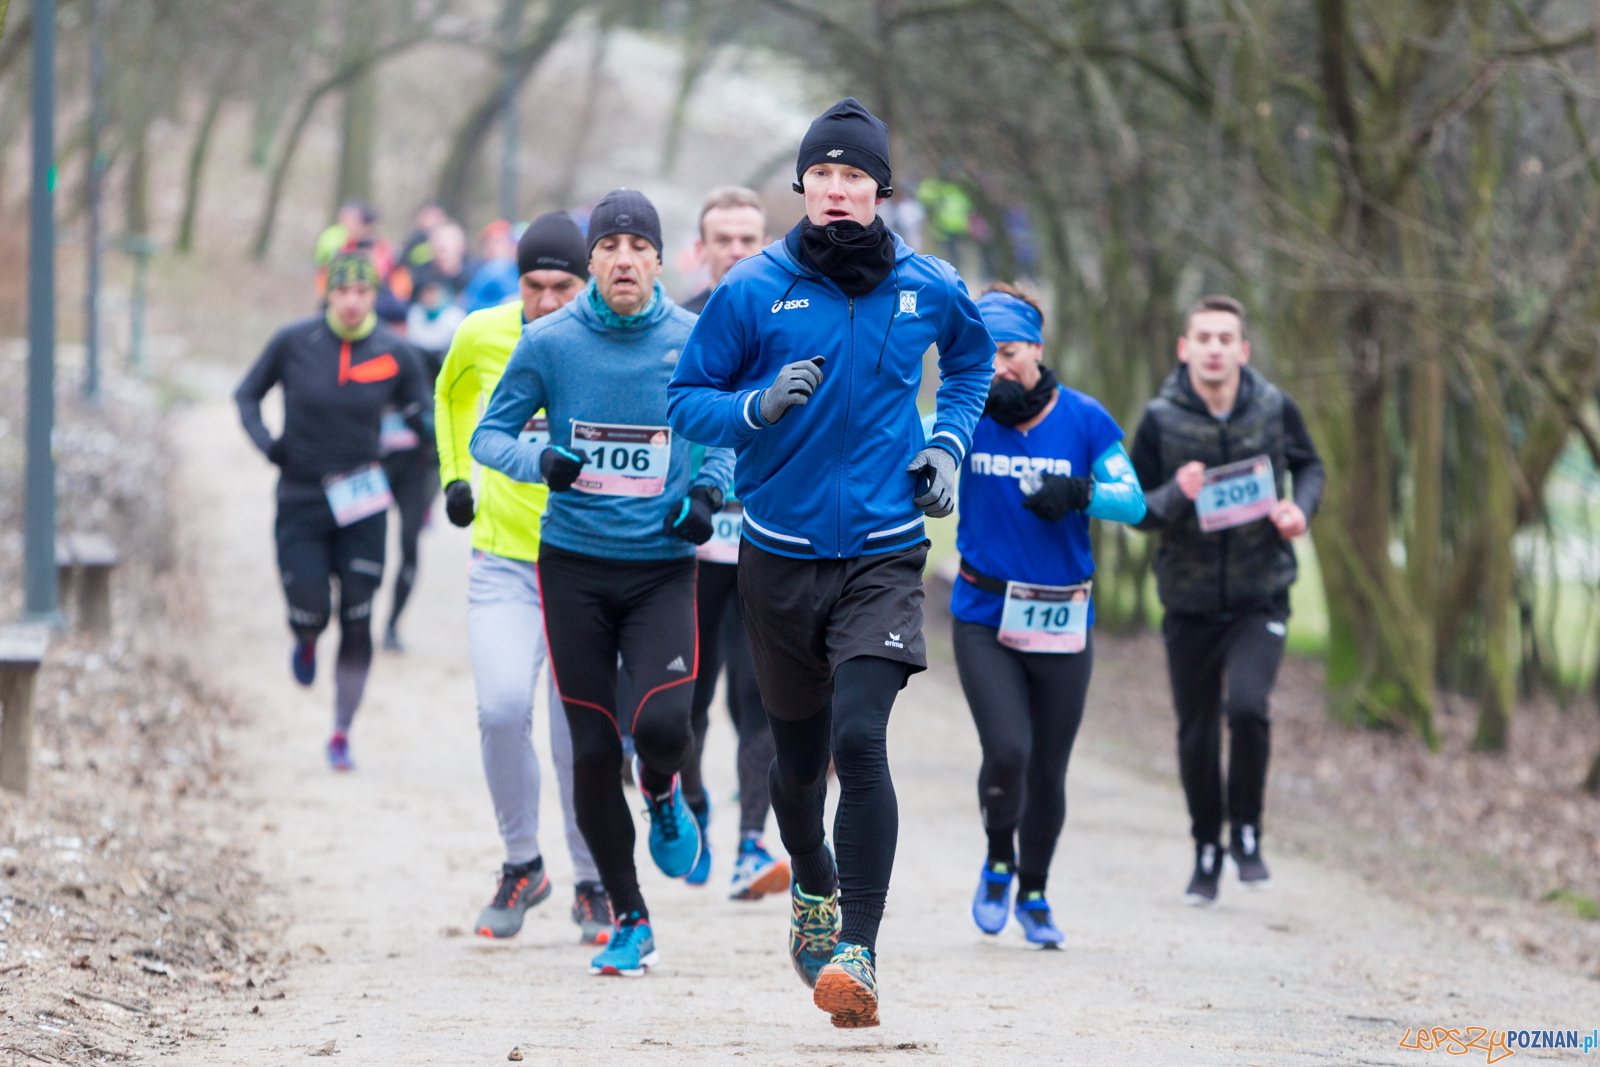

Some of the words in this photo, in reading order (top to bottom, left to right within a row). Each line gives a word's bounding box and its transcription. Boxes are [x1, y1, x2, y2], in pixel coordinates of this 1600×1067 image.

[826, 149, 844, 158] 4F
[591, 446, 650, 472] 106
[1213, 481, 1259, 508] 209
[1023, 605, 1069, 628] 110
[884, 640, 904, 649] erima
